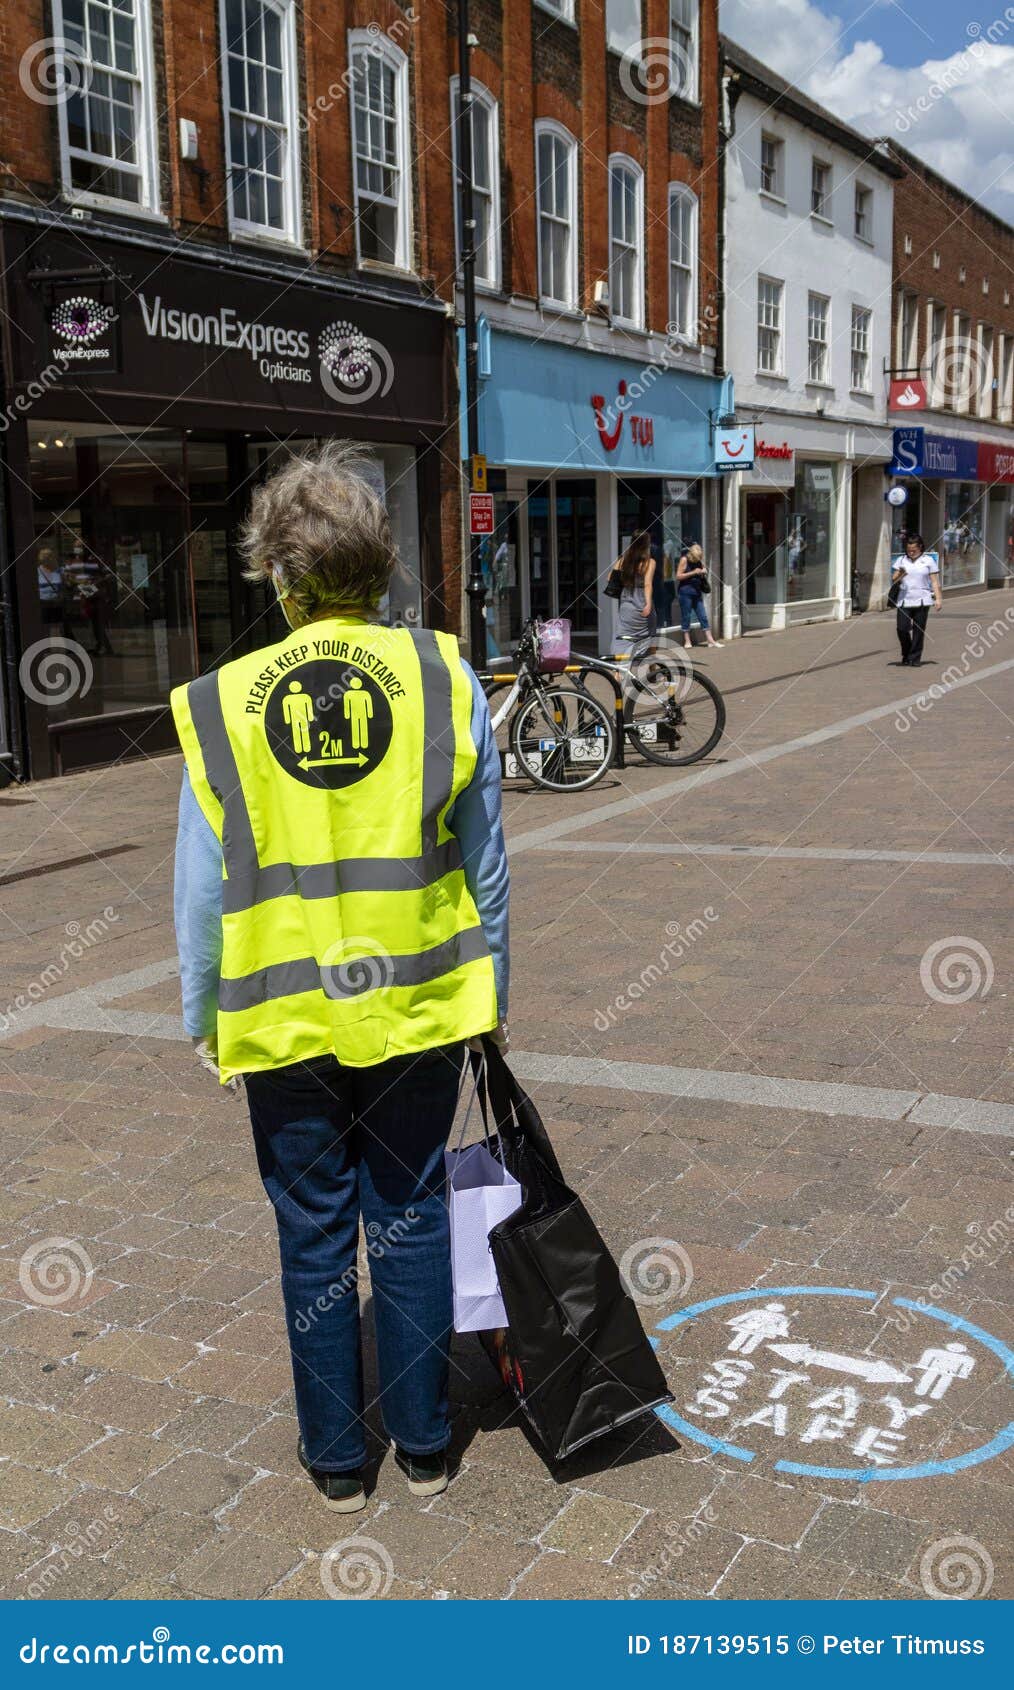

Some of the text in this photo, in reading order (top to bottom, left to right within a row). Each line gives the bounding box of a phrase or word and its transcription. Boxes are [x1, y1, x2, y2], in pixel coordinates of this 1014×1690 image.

[138, 293, 310, 360] VisionExpress
[53, 348, 110, 361] VisionExpress
[260, 358, 312, 383] Opticians
[630, 415, 654, 446] TUI
[900, 429, 918, 439] WH
[897, 439, 918, 471] S
[246, 640, 406, 714] PLEASE KEEP YOUR DISTANCE
[702, 1358, 933, 1429] STAY
[685, 1387, 907, 1464] SAFE
